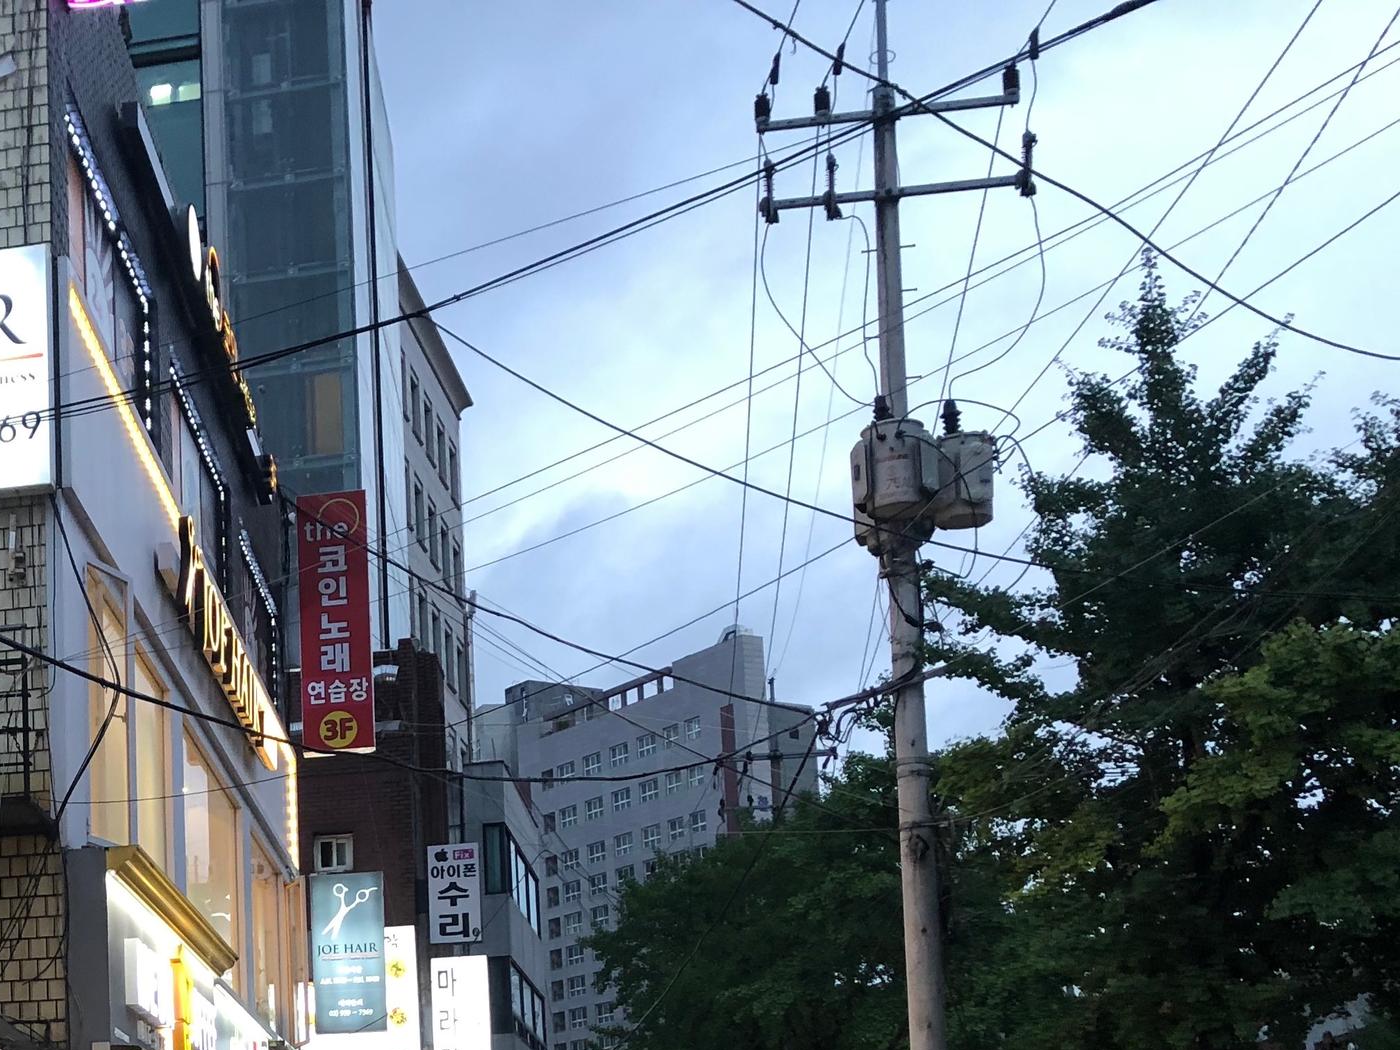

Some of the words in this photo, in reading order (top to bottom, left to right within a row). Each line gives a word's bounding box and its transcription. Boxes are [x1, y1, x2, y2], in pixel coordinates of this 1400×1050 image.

[316, 545, 352, 673] 코인노래
[307, 676, 369, 705] 연습장
[323, 717, 354, 741] 3F
[430, 863, 477, 880] 아이폰
[437, 881, 471, 938] 수리
[317, 943, 340, 957] JOE
[344, 942, 378, 954] HAIR
